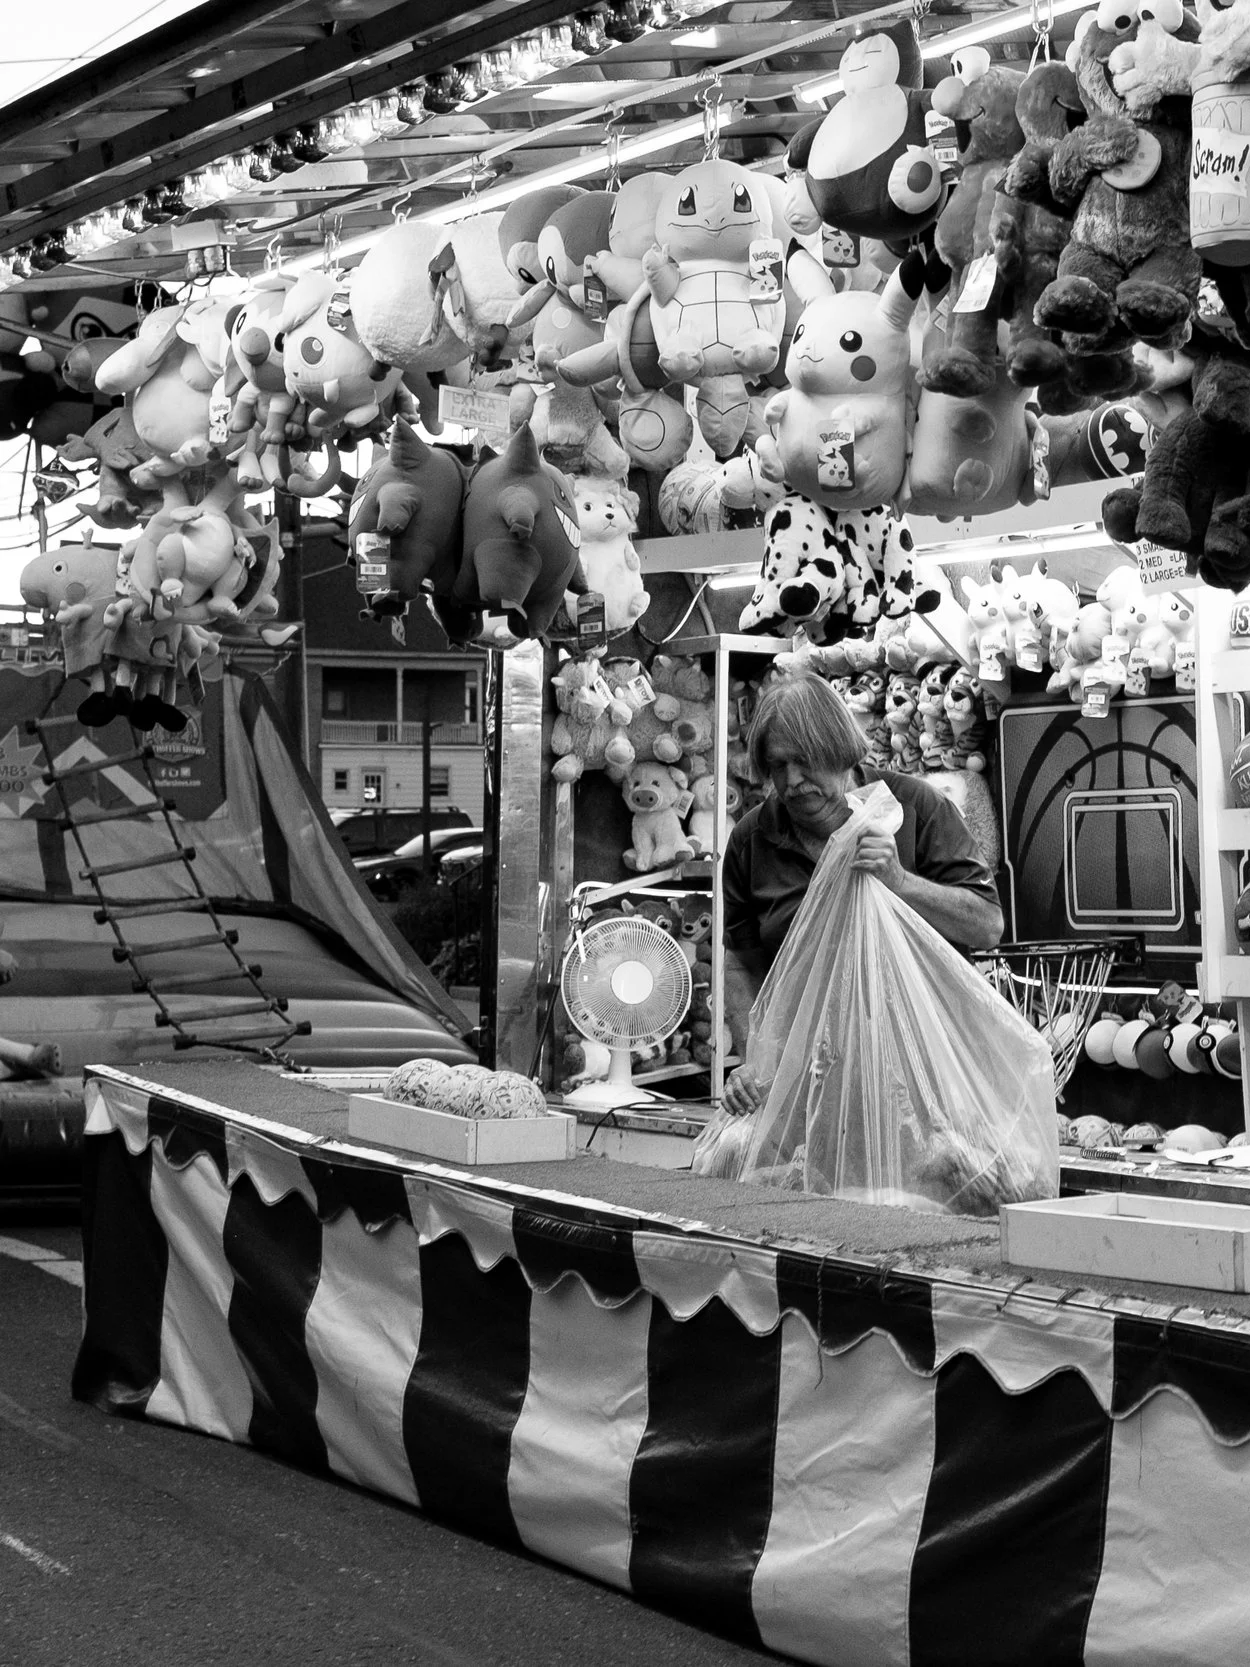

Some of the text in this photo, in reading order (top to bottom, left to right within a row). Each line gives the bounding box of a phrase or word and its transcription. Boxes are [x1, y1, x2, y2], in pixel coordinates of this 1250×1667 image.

[1193, 138, 1250, 183] Scram!
[452, 393, 496, 410] EXTRA
[452, 408, 496, 424] LARGE
[1140, 559, 1145, 570] 2
[1146, 555, 1163, 568] MED
